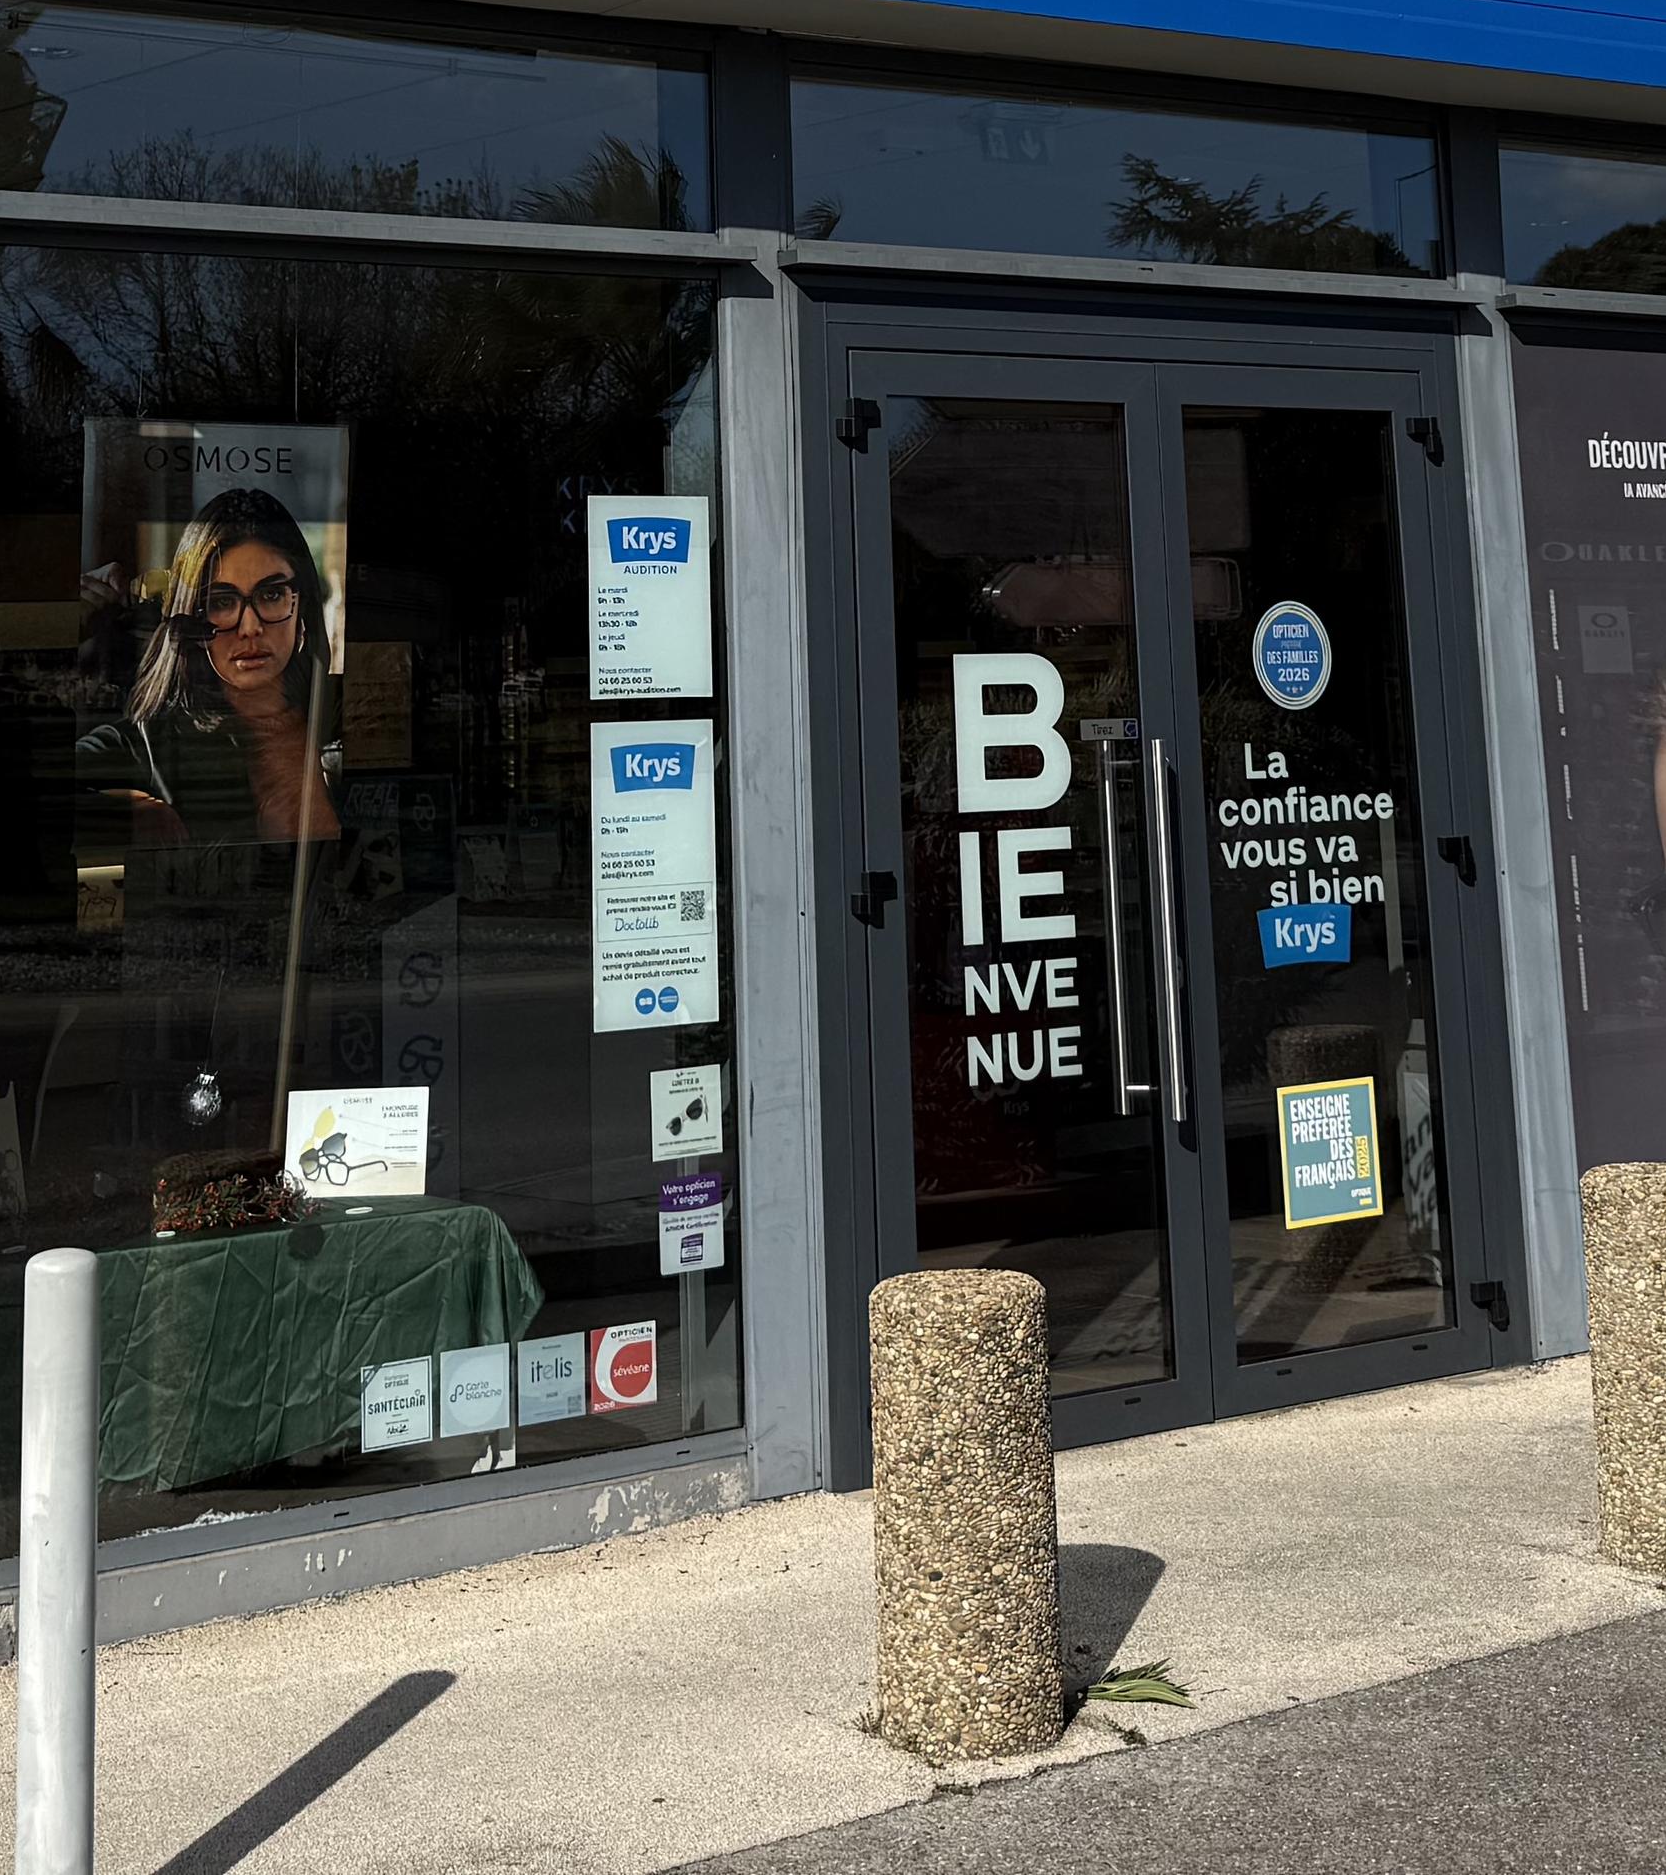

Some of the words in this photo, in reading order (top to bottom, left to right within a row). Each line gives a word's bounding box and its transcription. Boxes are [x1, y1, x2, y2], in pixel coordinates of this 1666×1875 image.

[144, 444, 292, 474] OSMOSE
[1623, 482, 1634, 498] IA
[622, 526, 677, 555] Krys
[623, 565, 677, 575] AUDITION
[1273, 623, 1309, 638] OPTICIEN
[1266, 651, 1282, 664] DES
[1282, 650, 1318, 664] FAMILLES
[1278, 668, 1310, 681] 2026
[953, 653, 1072, 813] B
[625, 753, 681, 782] Krys
[1244, 743, 1289, 779] La
[1219, 786, 1394, 827] confiance
[1221, 838, 1307, 869] vous
[1315, 834, 1359, 863] va
[959, 827, 1076, 946] IE
[1270, 870, 1298, 908] si
[1308, 868, 1385, 905] bien
[614, 916, 659, 932] Doctolib
[1275, 917, 1336, 953] Krys
[964, 957, 1079, 1016] NVE
[967, 1026, 1083, 1086] NUE
[1290, 1094, 1350, 1122] ENSEIGNE
[1329, 1136, 1353, 1160] DES
[1356, 1137, 1370, 1178] 2025
[662, 1185, 684, 1195] Votre
[685, 1178, 716, 1193] opticien
[1294, 1158, 1356, 1189] FRANÇAIS
[673, 1193, 709, 1205] s'engage
[610, 1326, 652, 1339] OPTICIEN
[531, 1357, 573, 1383] itelis
[465, 1381, 489, 1391] Carte
[465, 1388, 502, 1401] blanche
[367, 1391, 426, 1415] SANTÉCLAIR
